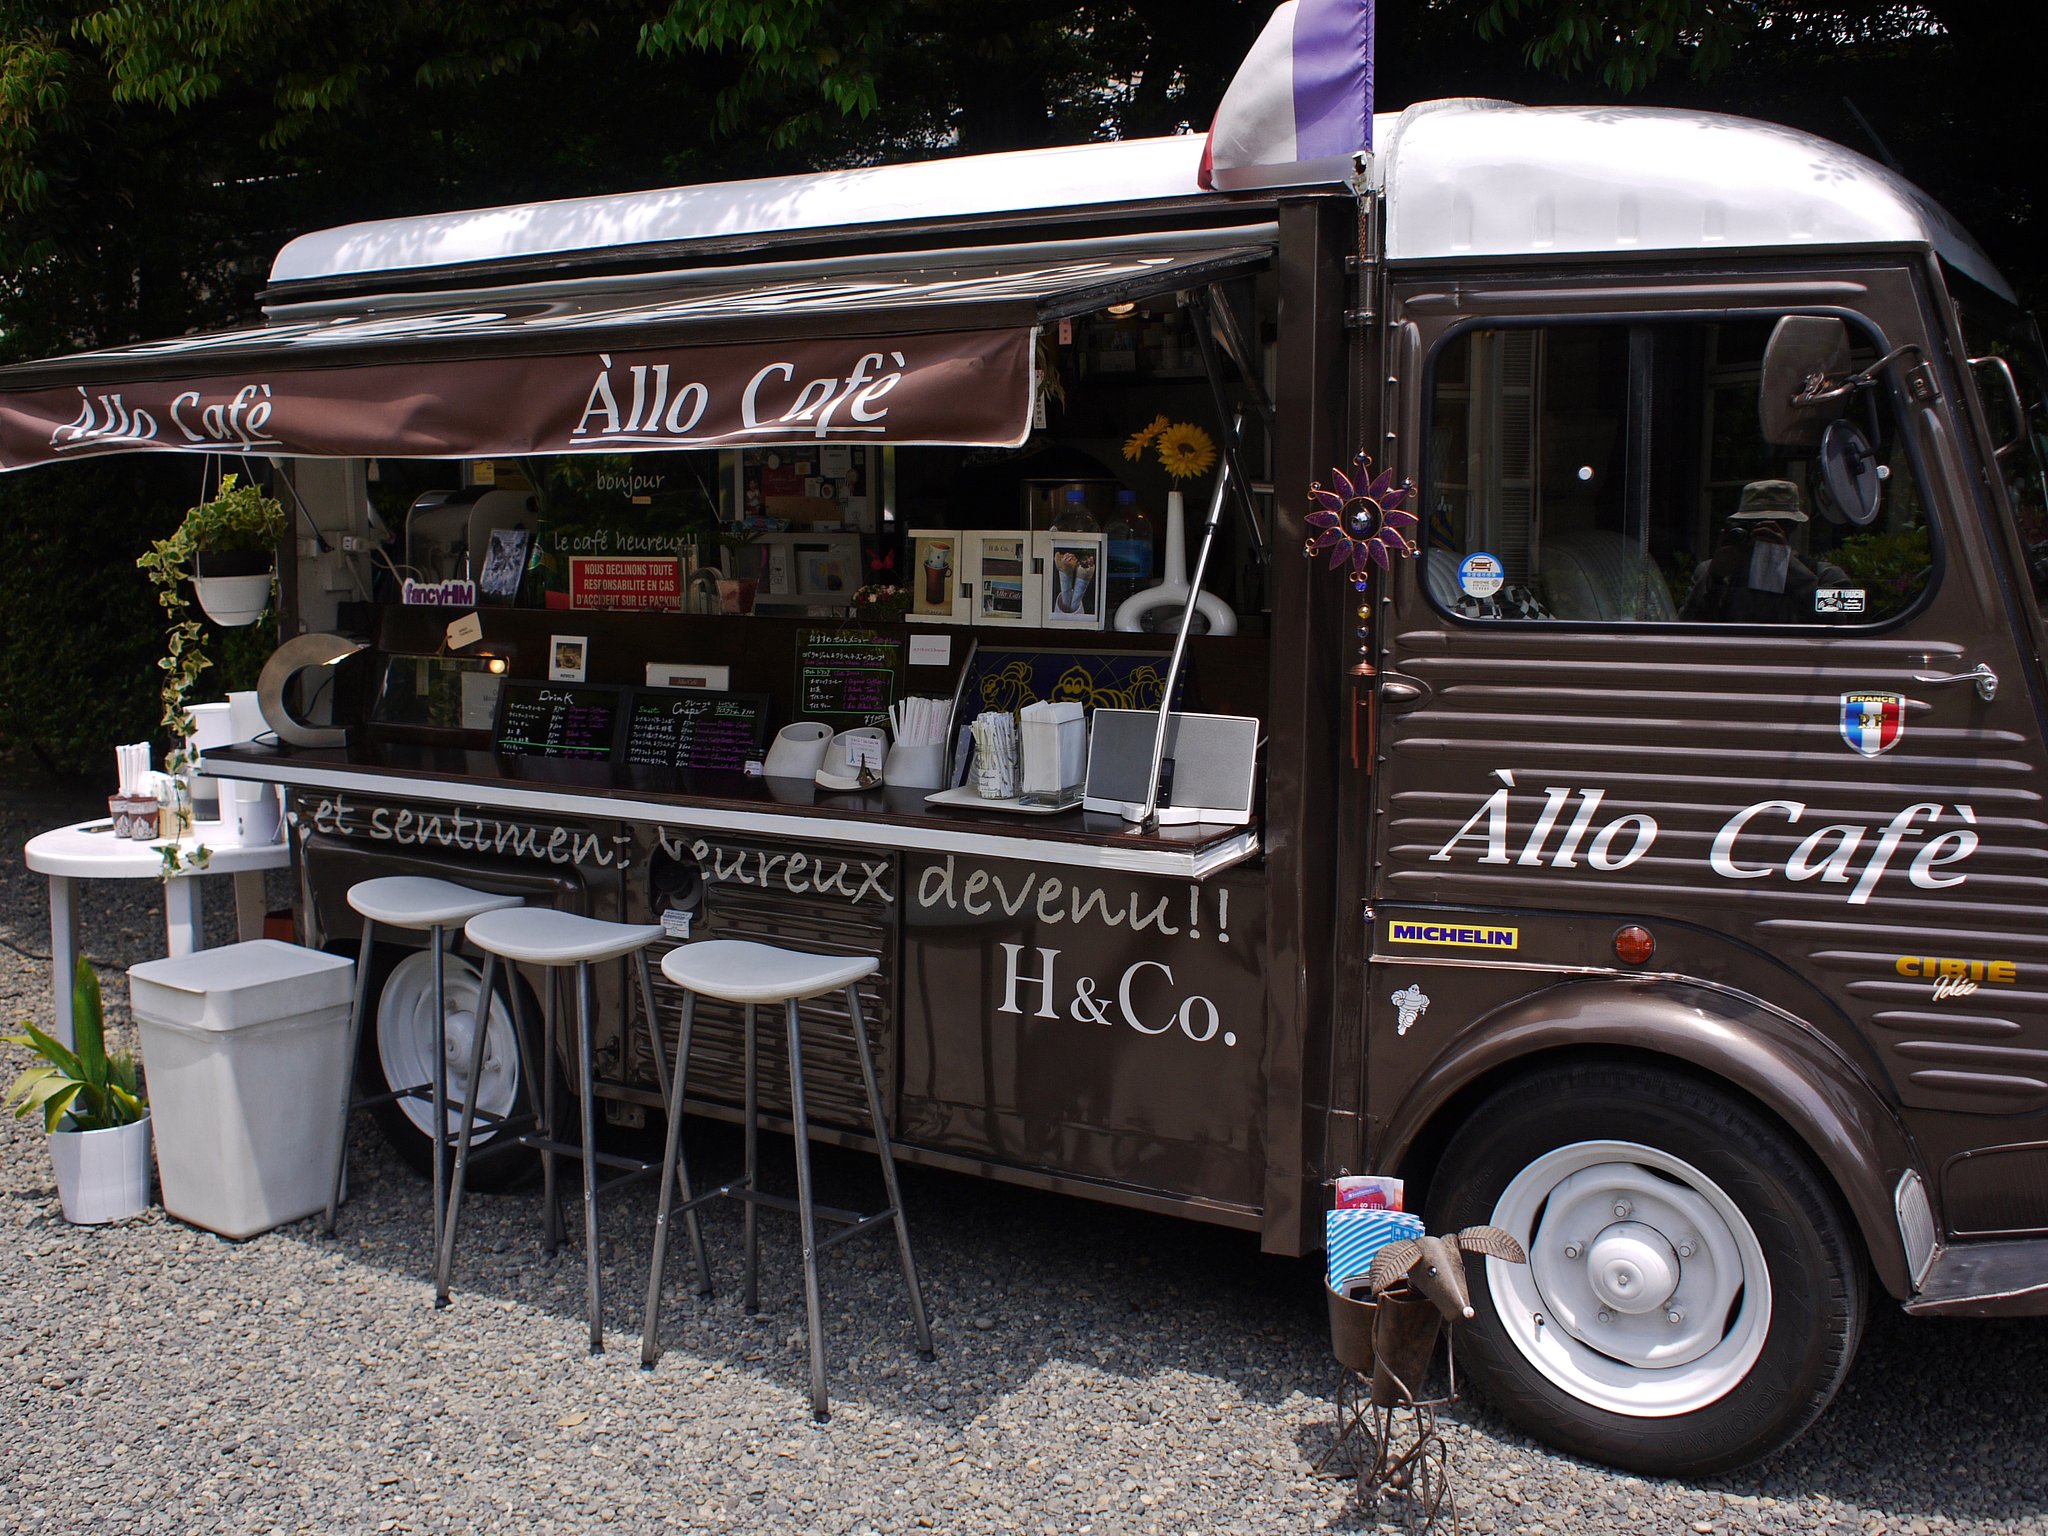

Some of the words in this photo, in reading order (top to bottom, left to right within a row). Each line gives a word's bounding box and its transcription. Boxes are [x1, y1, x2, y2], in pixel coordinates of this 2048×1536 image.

[596, 466, 665, 499] bonjour
[554, 531, 569, 551] le
[584, 563, 605, 576] NOUS
[606, 563, 647, 576] DECLINONS
[649, 564, 673, 577] TOUTE
[584, 579, 647, 592] RESPONSABILITE
[647, 580, 658, 592] EN
[659, 580, 675, 592] CAS
[621, 595, 636, 607] SUR
[638, 596, 647, 607] LE
[1850, 695, 1897, 704] FRANCE
[1429, 769, 1658, 872] Àllo
[1710, 801, 1979, 905] Cafè
[313, 793, 355, 835] et
[917, 854, 1230, 944] devenu!!
[1393, 925, 1513, 946] MICHELIN
[1932, 974, 1980, 1003] Idée
